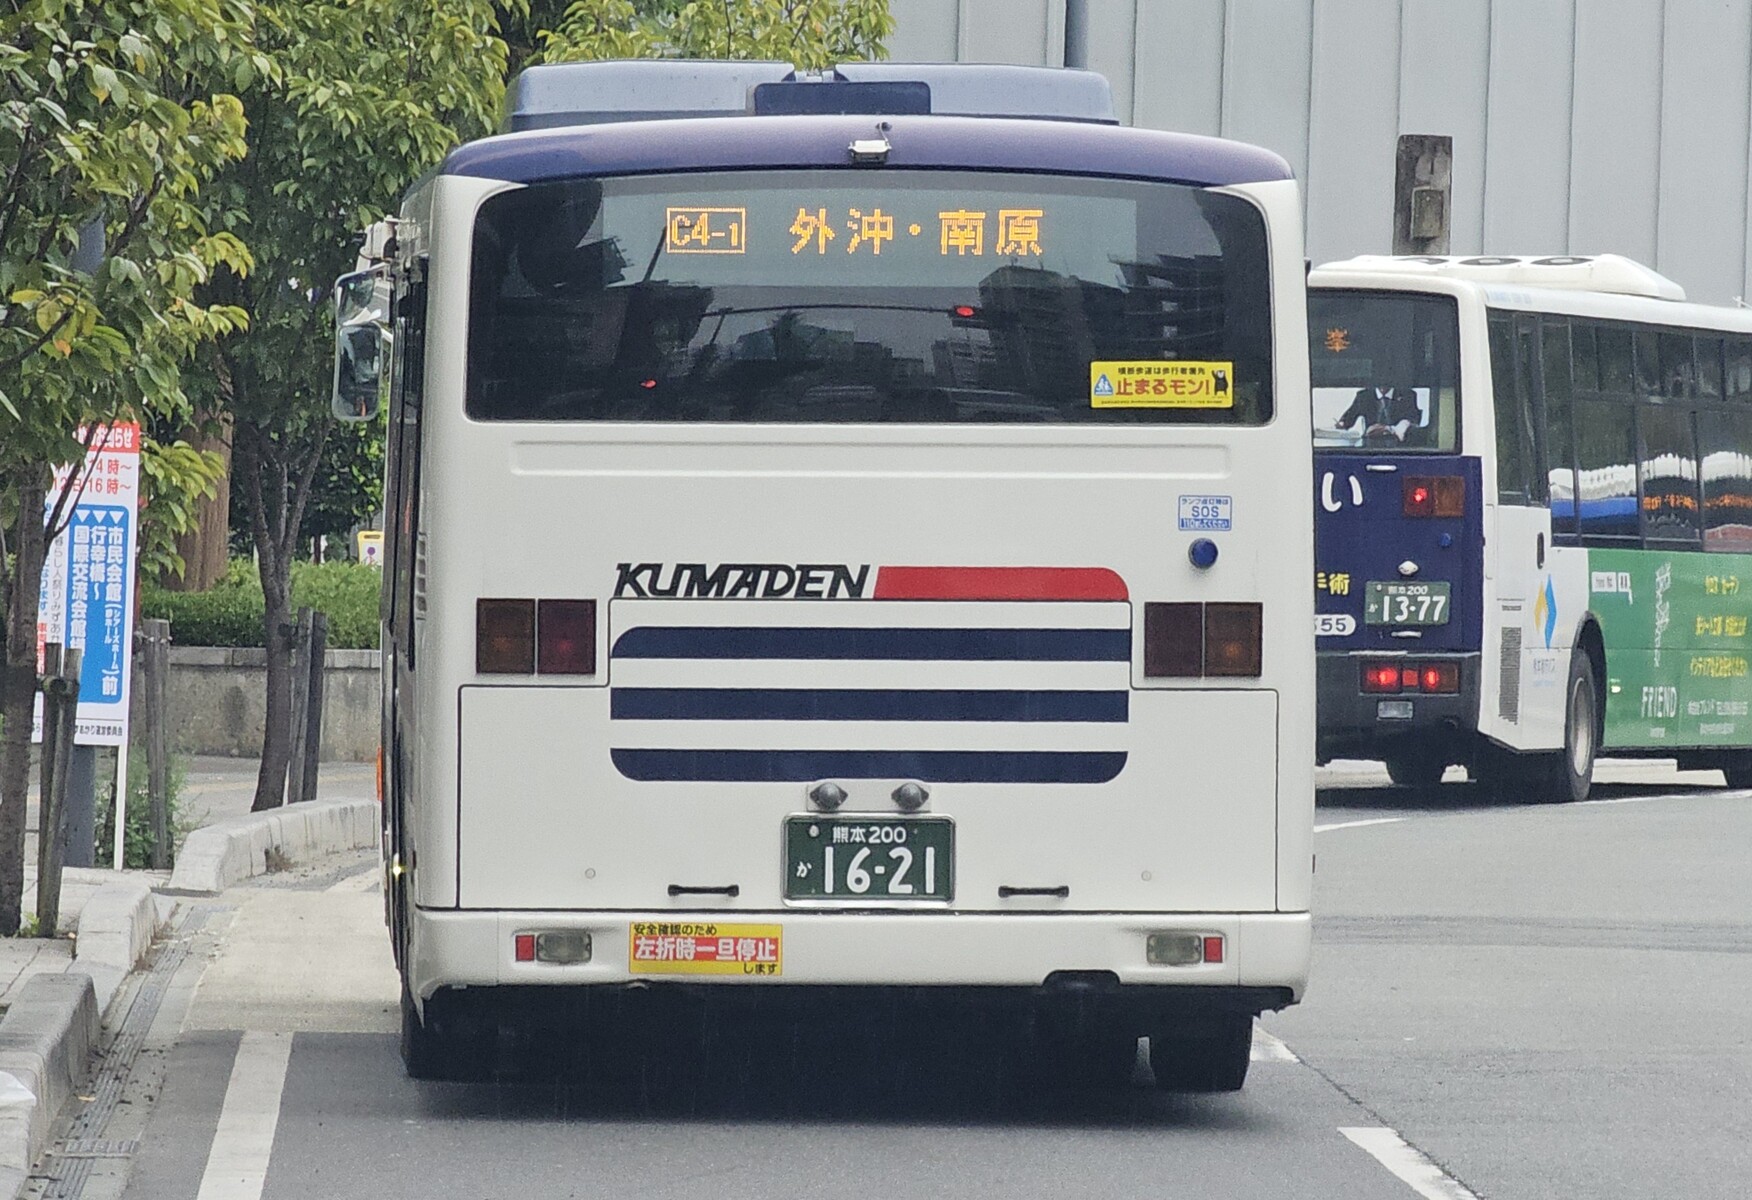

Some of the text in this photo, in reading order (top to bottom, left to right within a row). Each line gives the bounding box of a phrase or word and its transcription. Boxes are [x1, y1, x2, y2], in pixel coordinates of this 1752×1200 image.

[671, 212, 738, 246] C4-1
[1322, 472, 1363, 512] い
[1192, 505, 1219, 518] SOS
[613, 563, 870, 599] KUMADEN
[1314, 617, 1347, 633] 55
[796, 846, 935, 894] か 16-21
[633, 923, 717, 936] 安全確認のため
[634, 937, 777, 961] 左折時一旦停止
[743, 962, 778, 975] します
